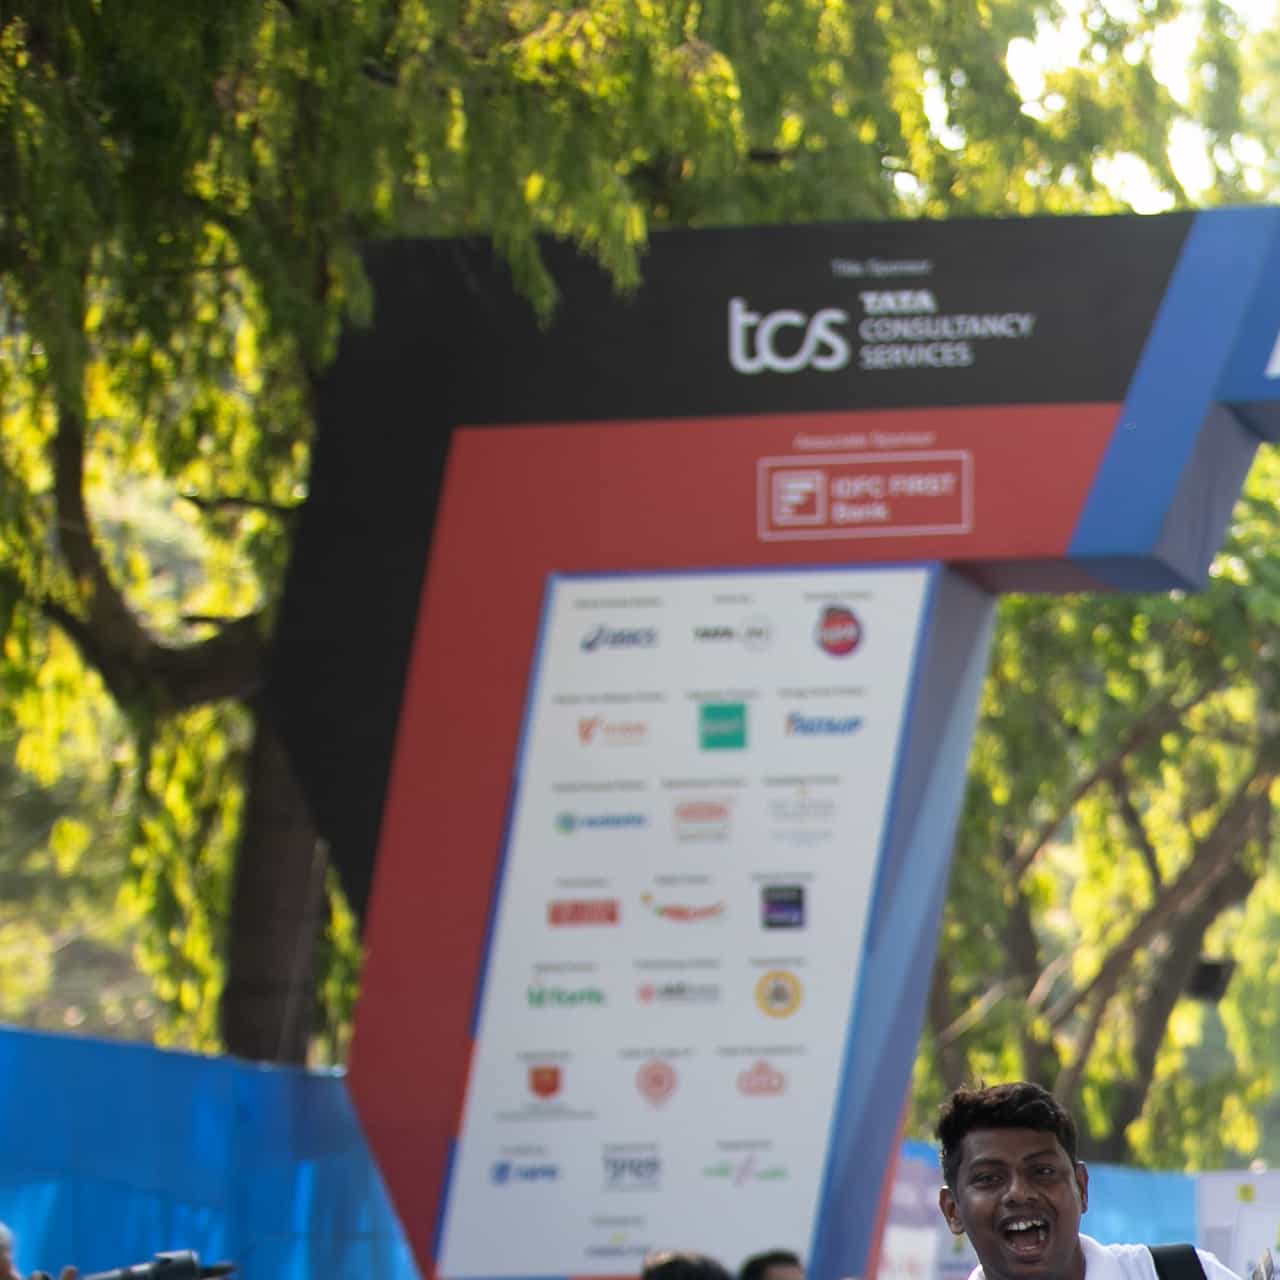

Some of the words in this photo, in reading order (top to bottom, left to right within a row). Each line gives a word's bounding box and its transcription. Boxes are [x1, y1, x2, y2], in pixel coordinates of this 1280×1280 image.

[858, 288, 938, 314] TATA
[728, 296, 850, 374] tcs
[858, 312, 1037, 342] CONSULTANCY
[859, 341, 975, 370] SERVICES
